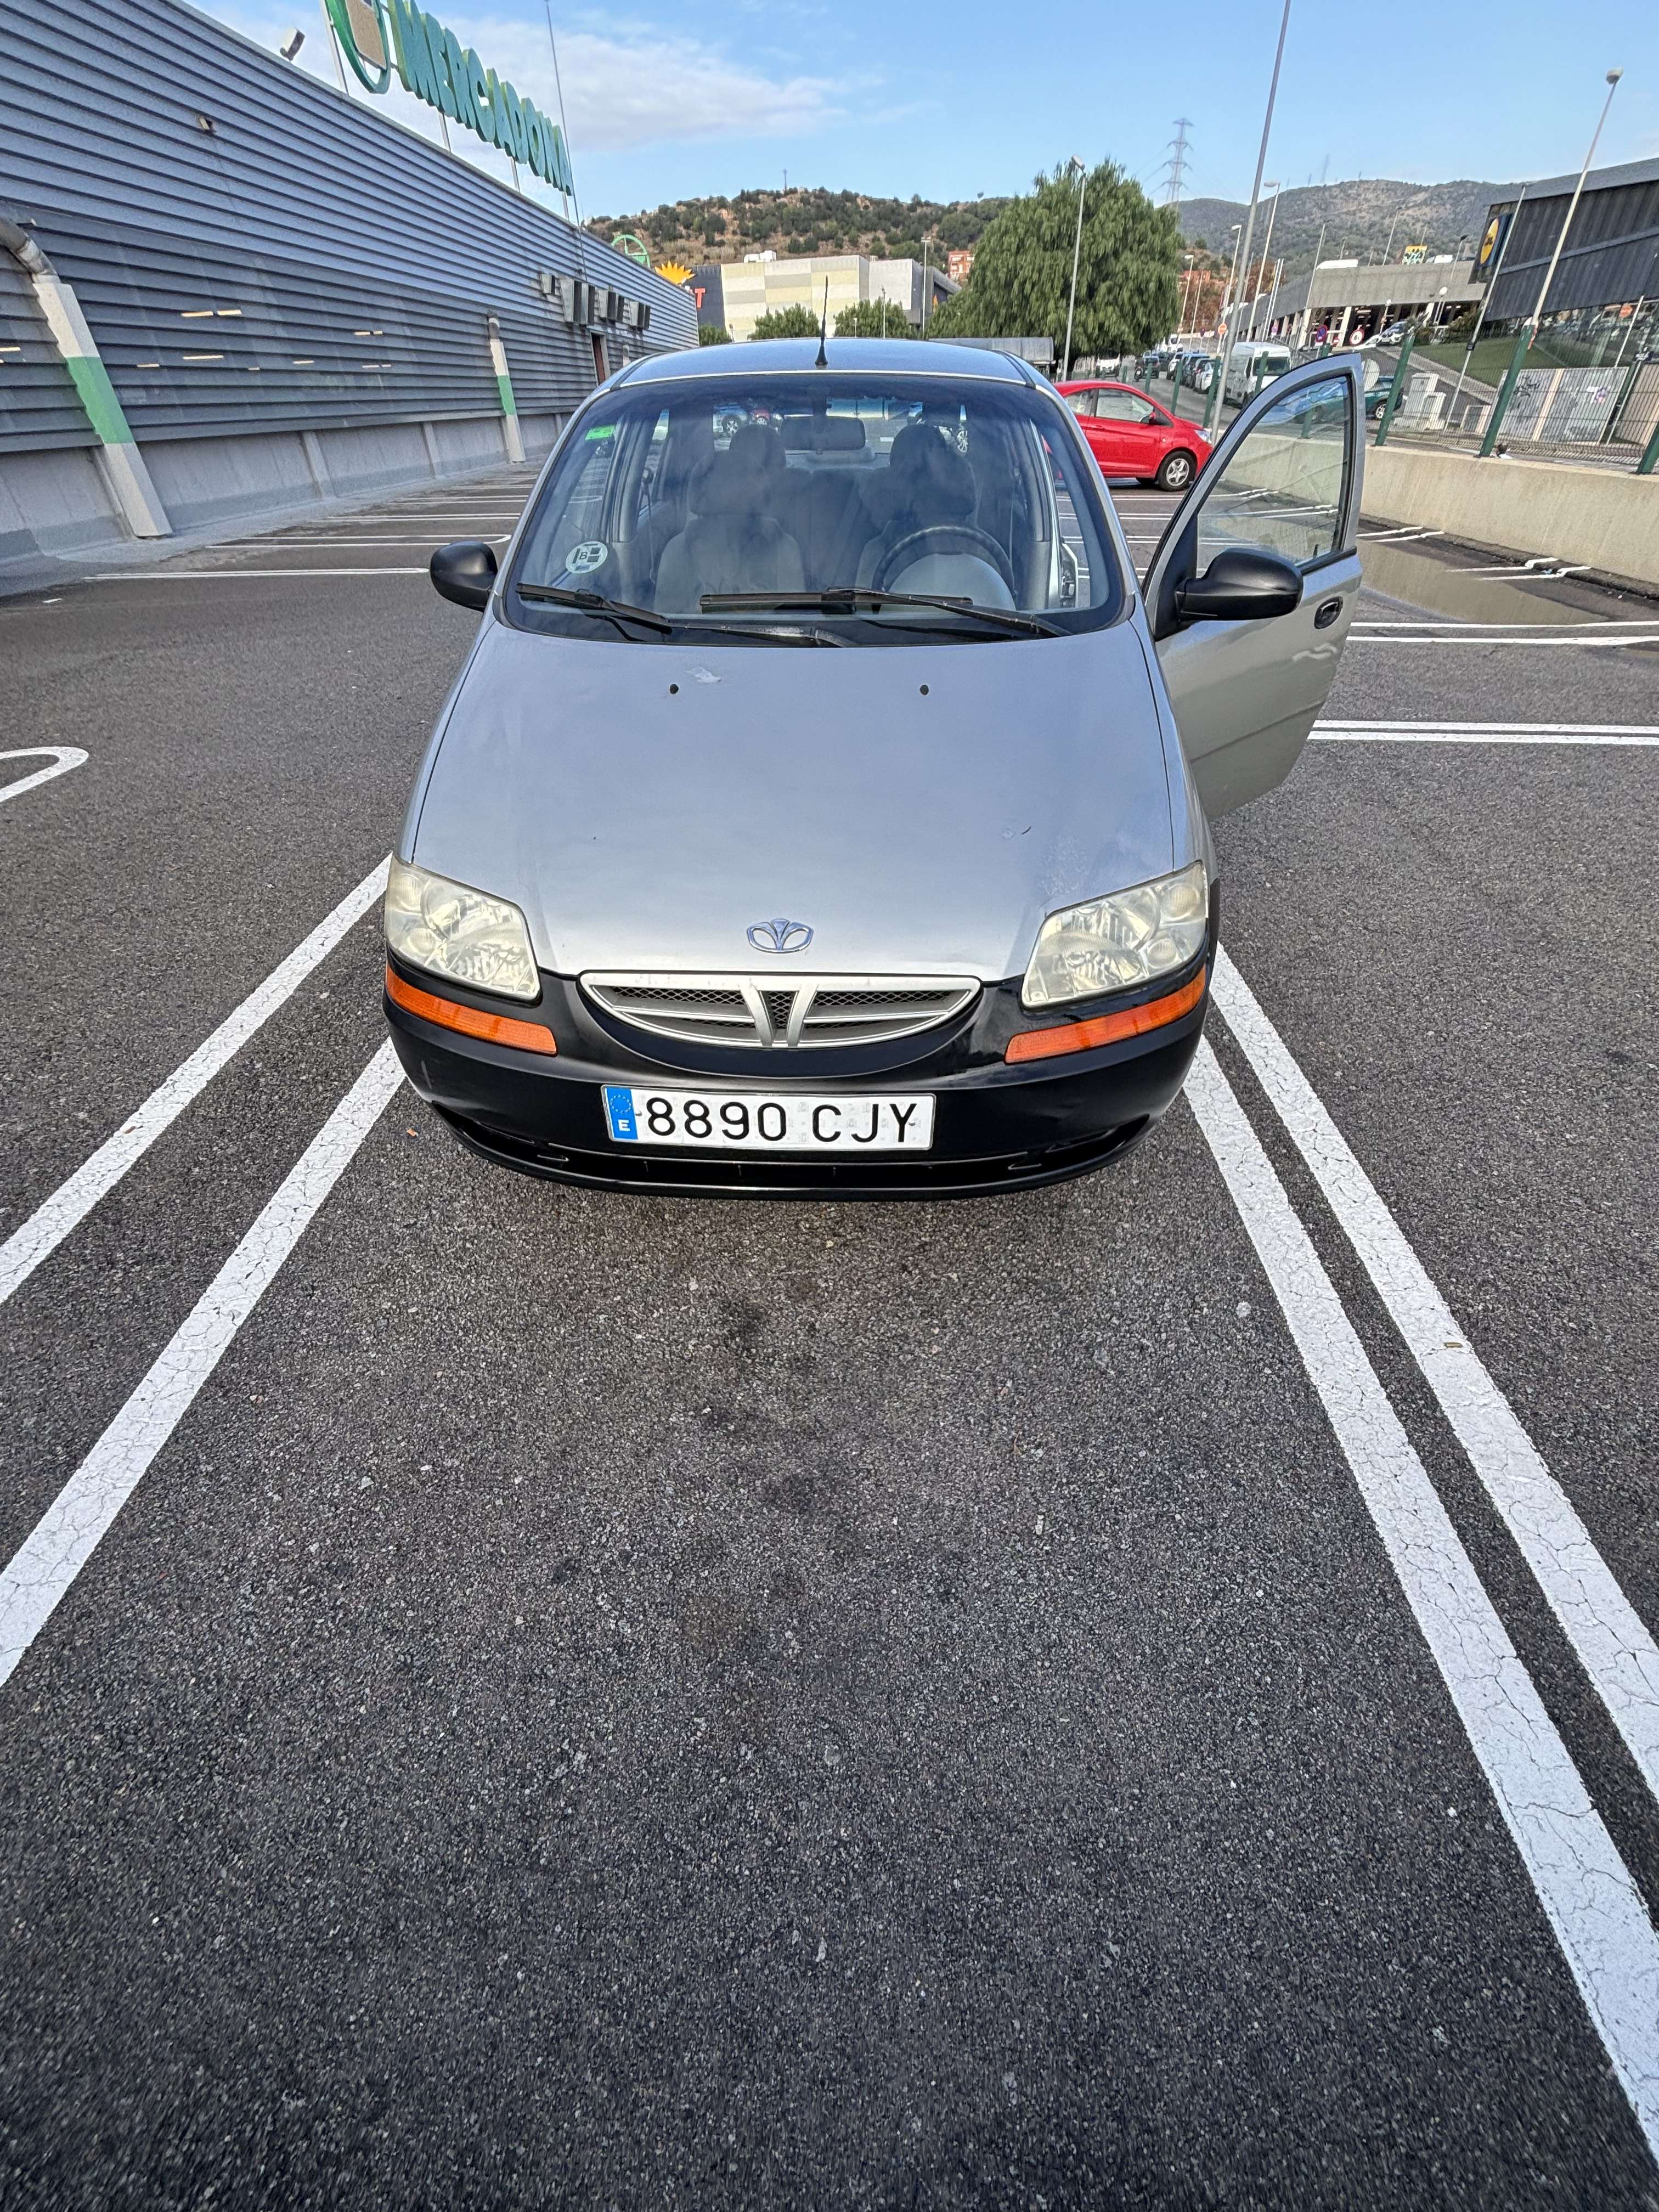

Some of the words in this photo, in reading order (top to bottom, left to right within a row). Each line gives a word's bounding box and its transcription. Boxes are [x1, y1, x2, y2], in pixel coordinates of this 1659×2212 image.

[618, 1119, 630, 1132] E
[646, 1097, 786, 1141] 8890
[812, 1103, 917, 1143] CJY
